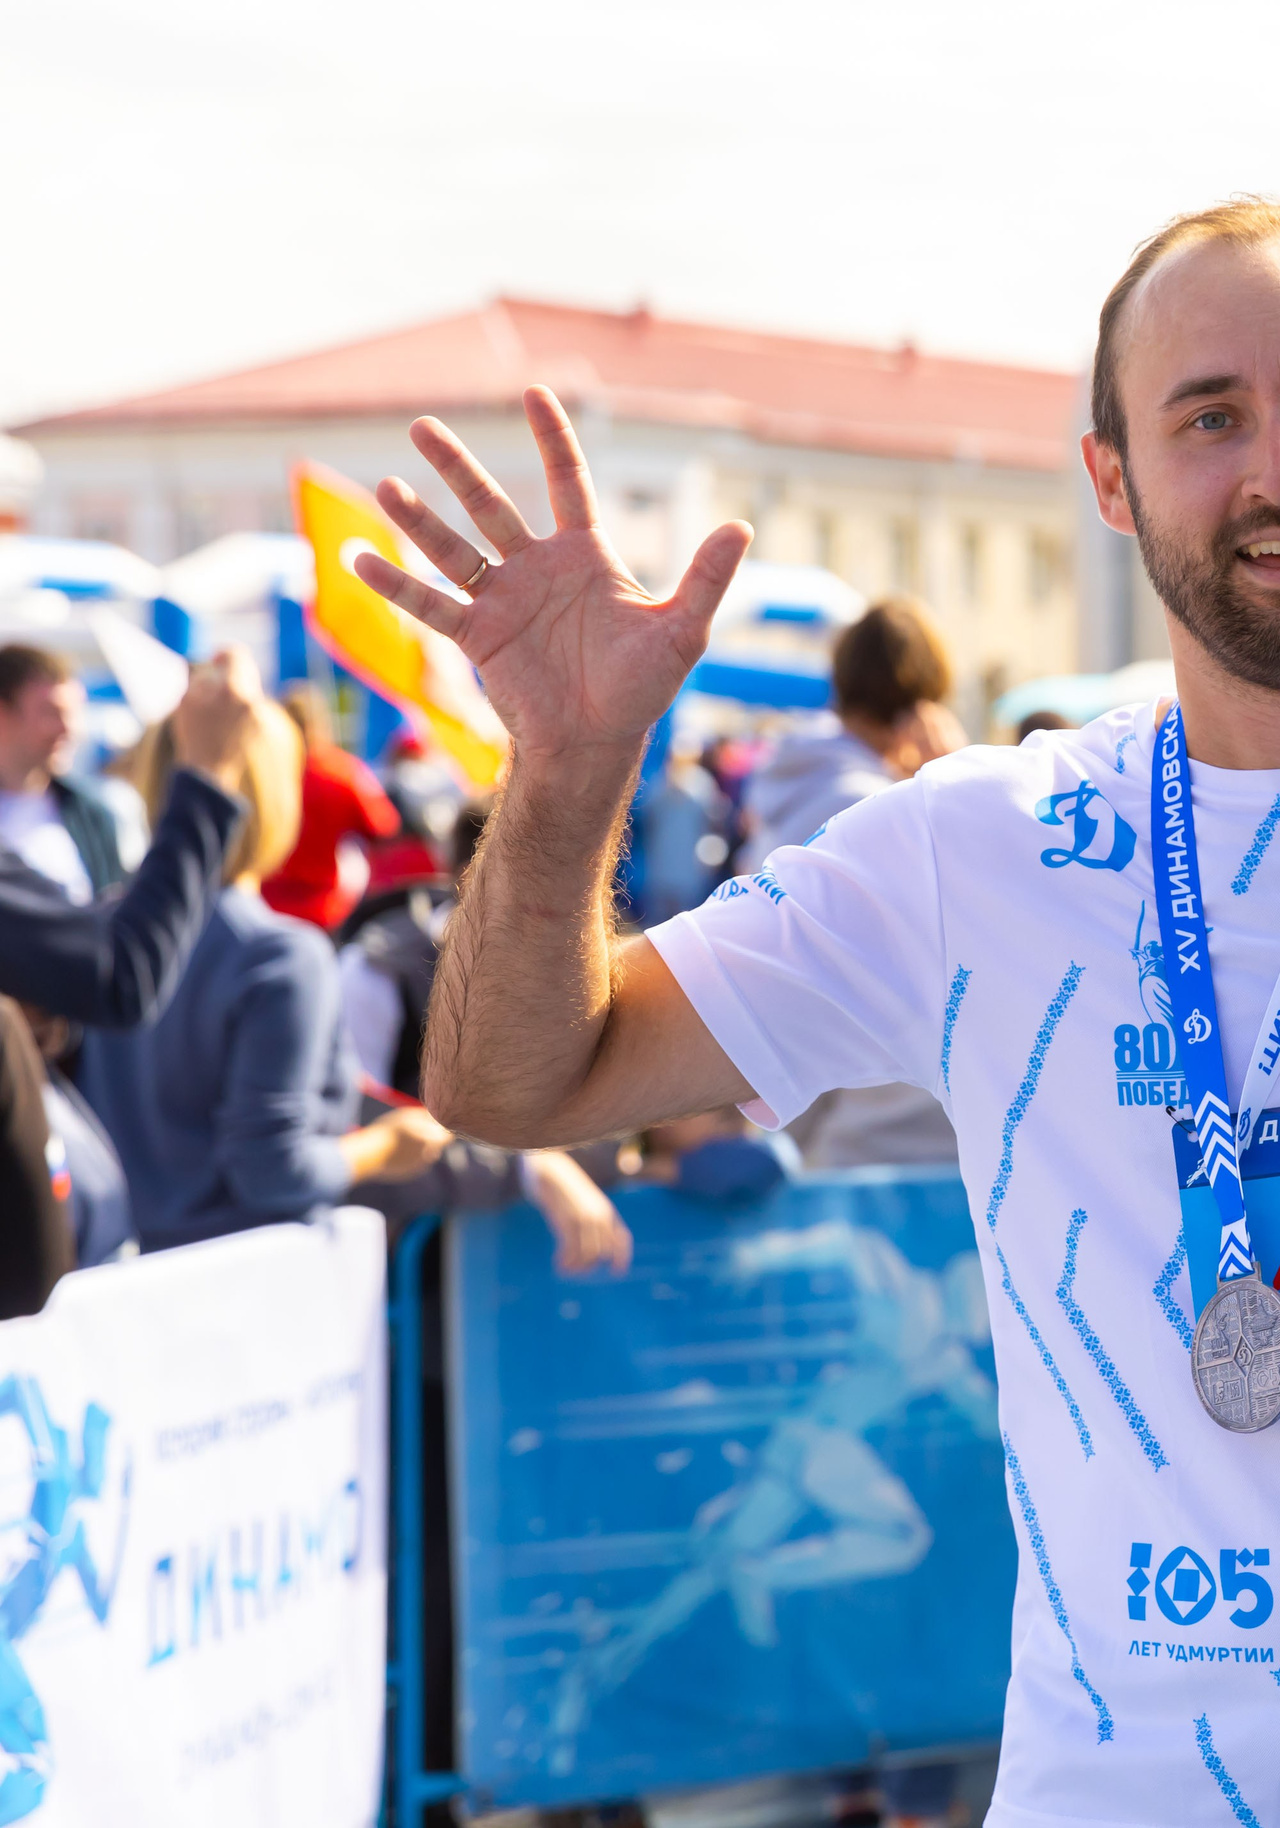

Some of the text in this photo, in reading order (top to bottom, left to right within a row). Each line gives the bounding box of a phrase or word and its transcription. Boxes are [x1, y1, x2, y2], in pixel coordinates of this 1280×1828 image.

[1162, 699, 1201, 975] XV ДИНАМОВСКА
[1114, 1023, 1171, 1071] 80
[1117, 1080, 1191, 1109] ПОБЕД
[1128, 1640, 1274, 1663] ЛЕТ УДМУРТИИ
